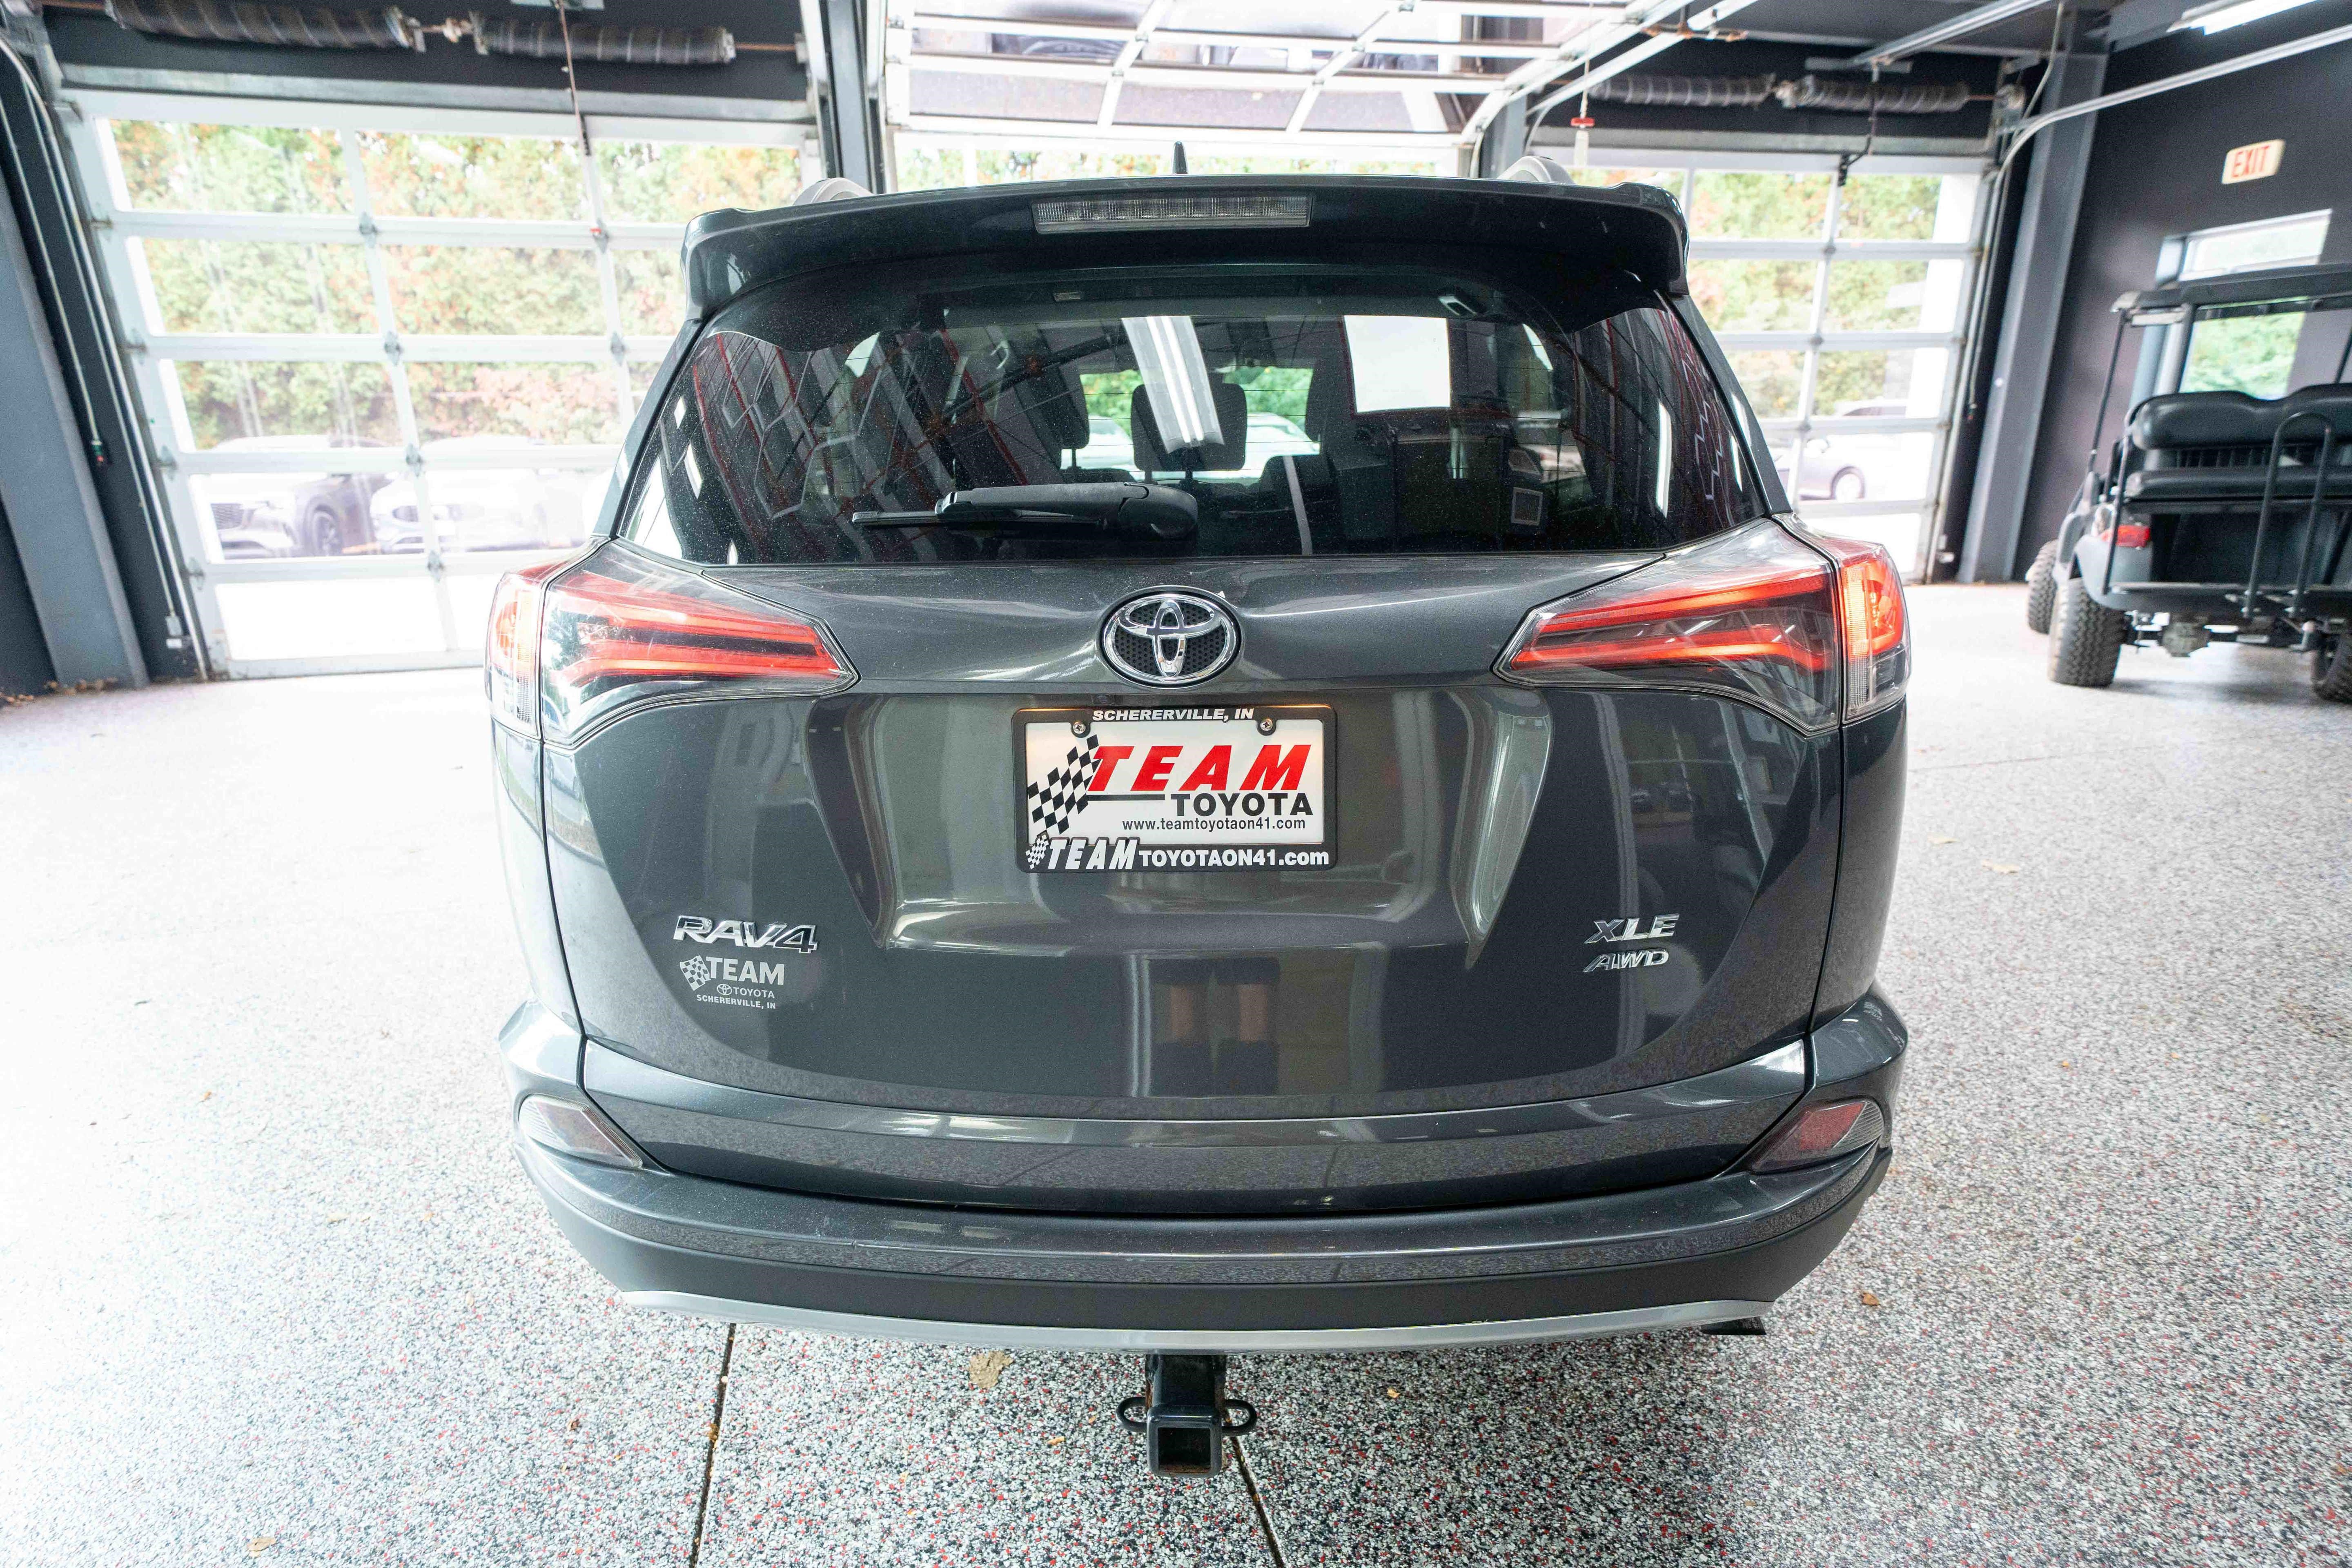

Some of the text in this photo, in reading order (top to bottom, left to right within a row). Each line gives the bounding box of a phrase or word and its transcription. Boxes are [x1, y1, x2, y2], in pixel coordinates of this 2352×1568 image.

[2232, 145, 2270, 177] EXIT
[1092, 708, 1254, 722] SCHERERVILLE, IN
[1088, 744, 1311, 791] TEAM
[1171, 793, 1313, 816] TOYOTA
[1122, 817, 1306, 832] www.teamtoyotaon41.com
[1048, 839, 1329, 870] TEAM TOYOTAON41.com
[673, 915, 818, 953] RAV4
[1584, 913, 1680, 944] XLE
[706, 956, 785, 985] TEAM
[1583, 949, 1669, 972] AWD
[696, 994, 764, 1009] SCHERERVILLE,
[733, 987, 775, 998] TOYOTA
